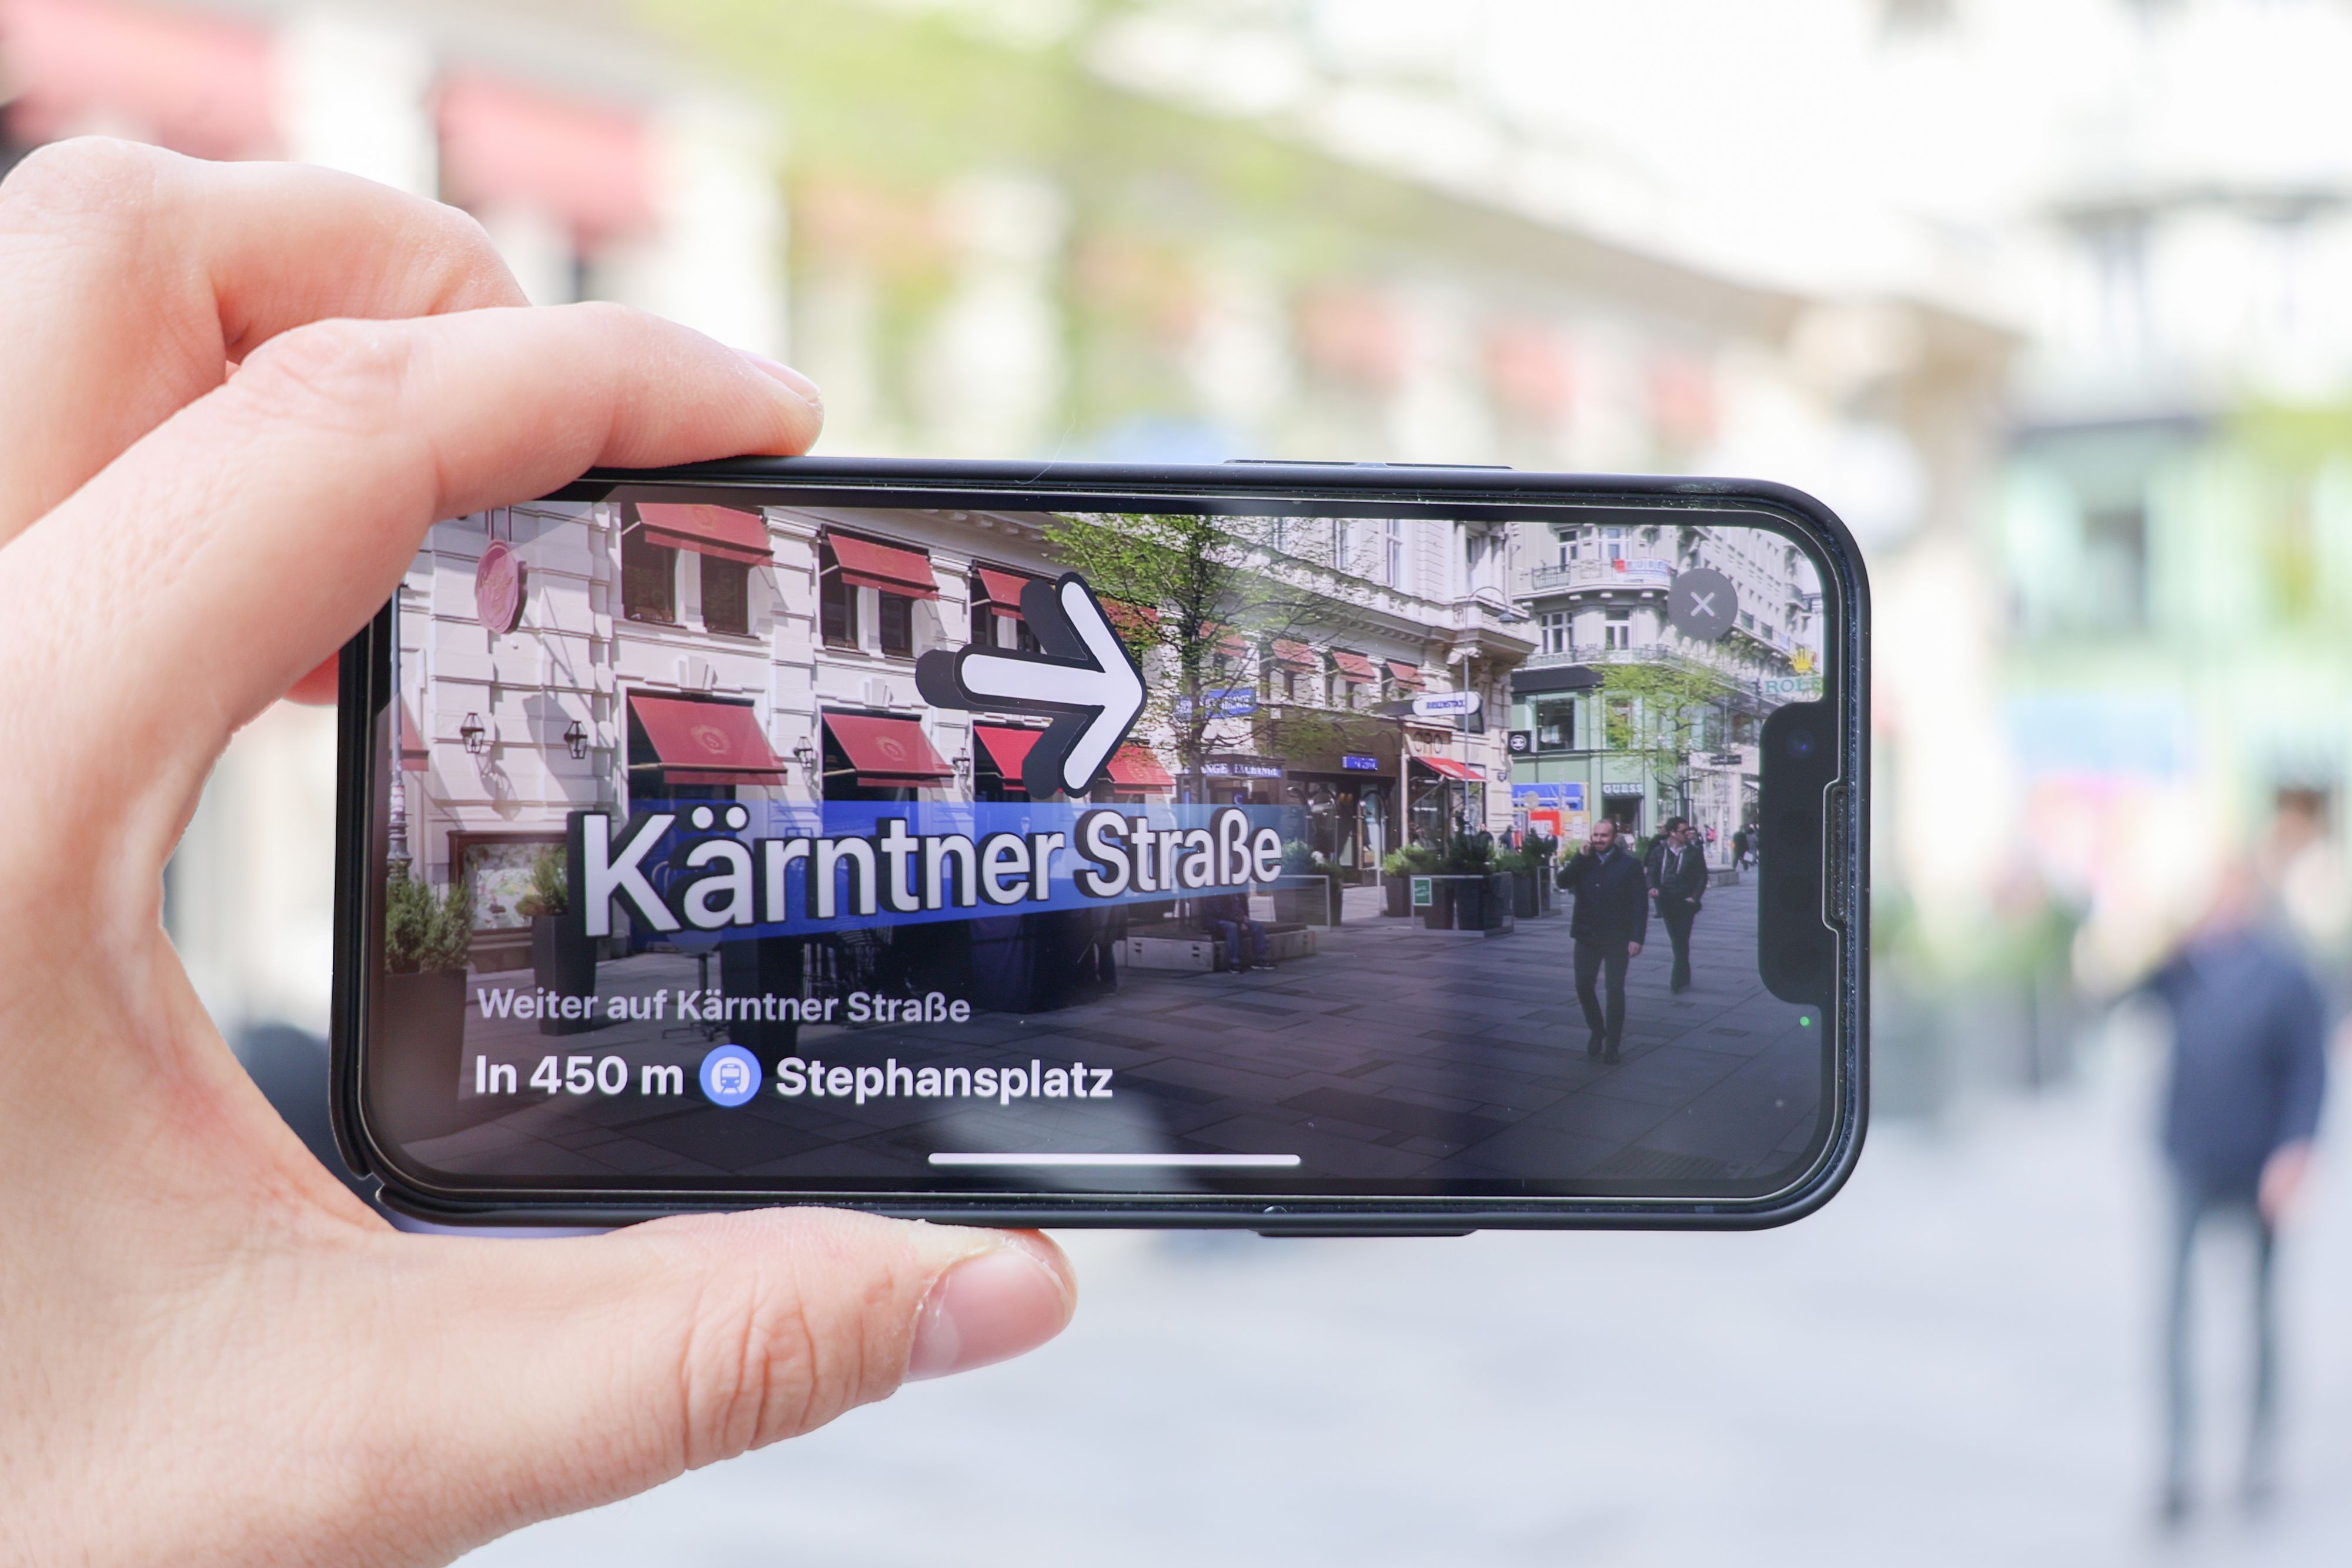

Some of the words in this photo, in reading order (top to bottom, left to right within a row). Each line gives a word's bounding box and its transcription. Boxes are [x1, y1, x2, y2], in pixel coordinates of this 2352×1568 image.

[1602, 784, 1643, 794] GUESS
[583, 807, 1065, 937] Kärntner
[1086, 808, 1282, 898] Straße
[476, 987, 599, 1019] Weiter
[607, 989, 668, 1019] auf
[677, 988, 838, 1021] Kärntner
[848, 992, 971, 1022] Straße
[476, 1055, 517, 1094] In
[530, 1055, 629, 1095] 450
[642, 1065, 684, 1095] m
[777, 1057, 1114, 1106] Stephansplatz
